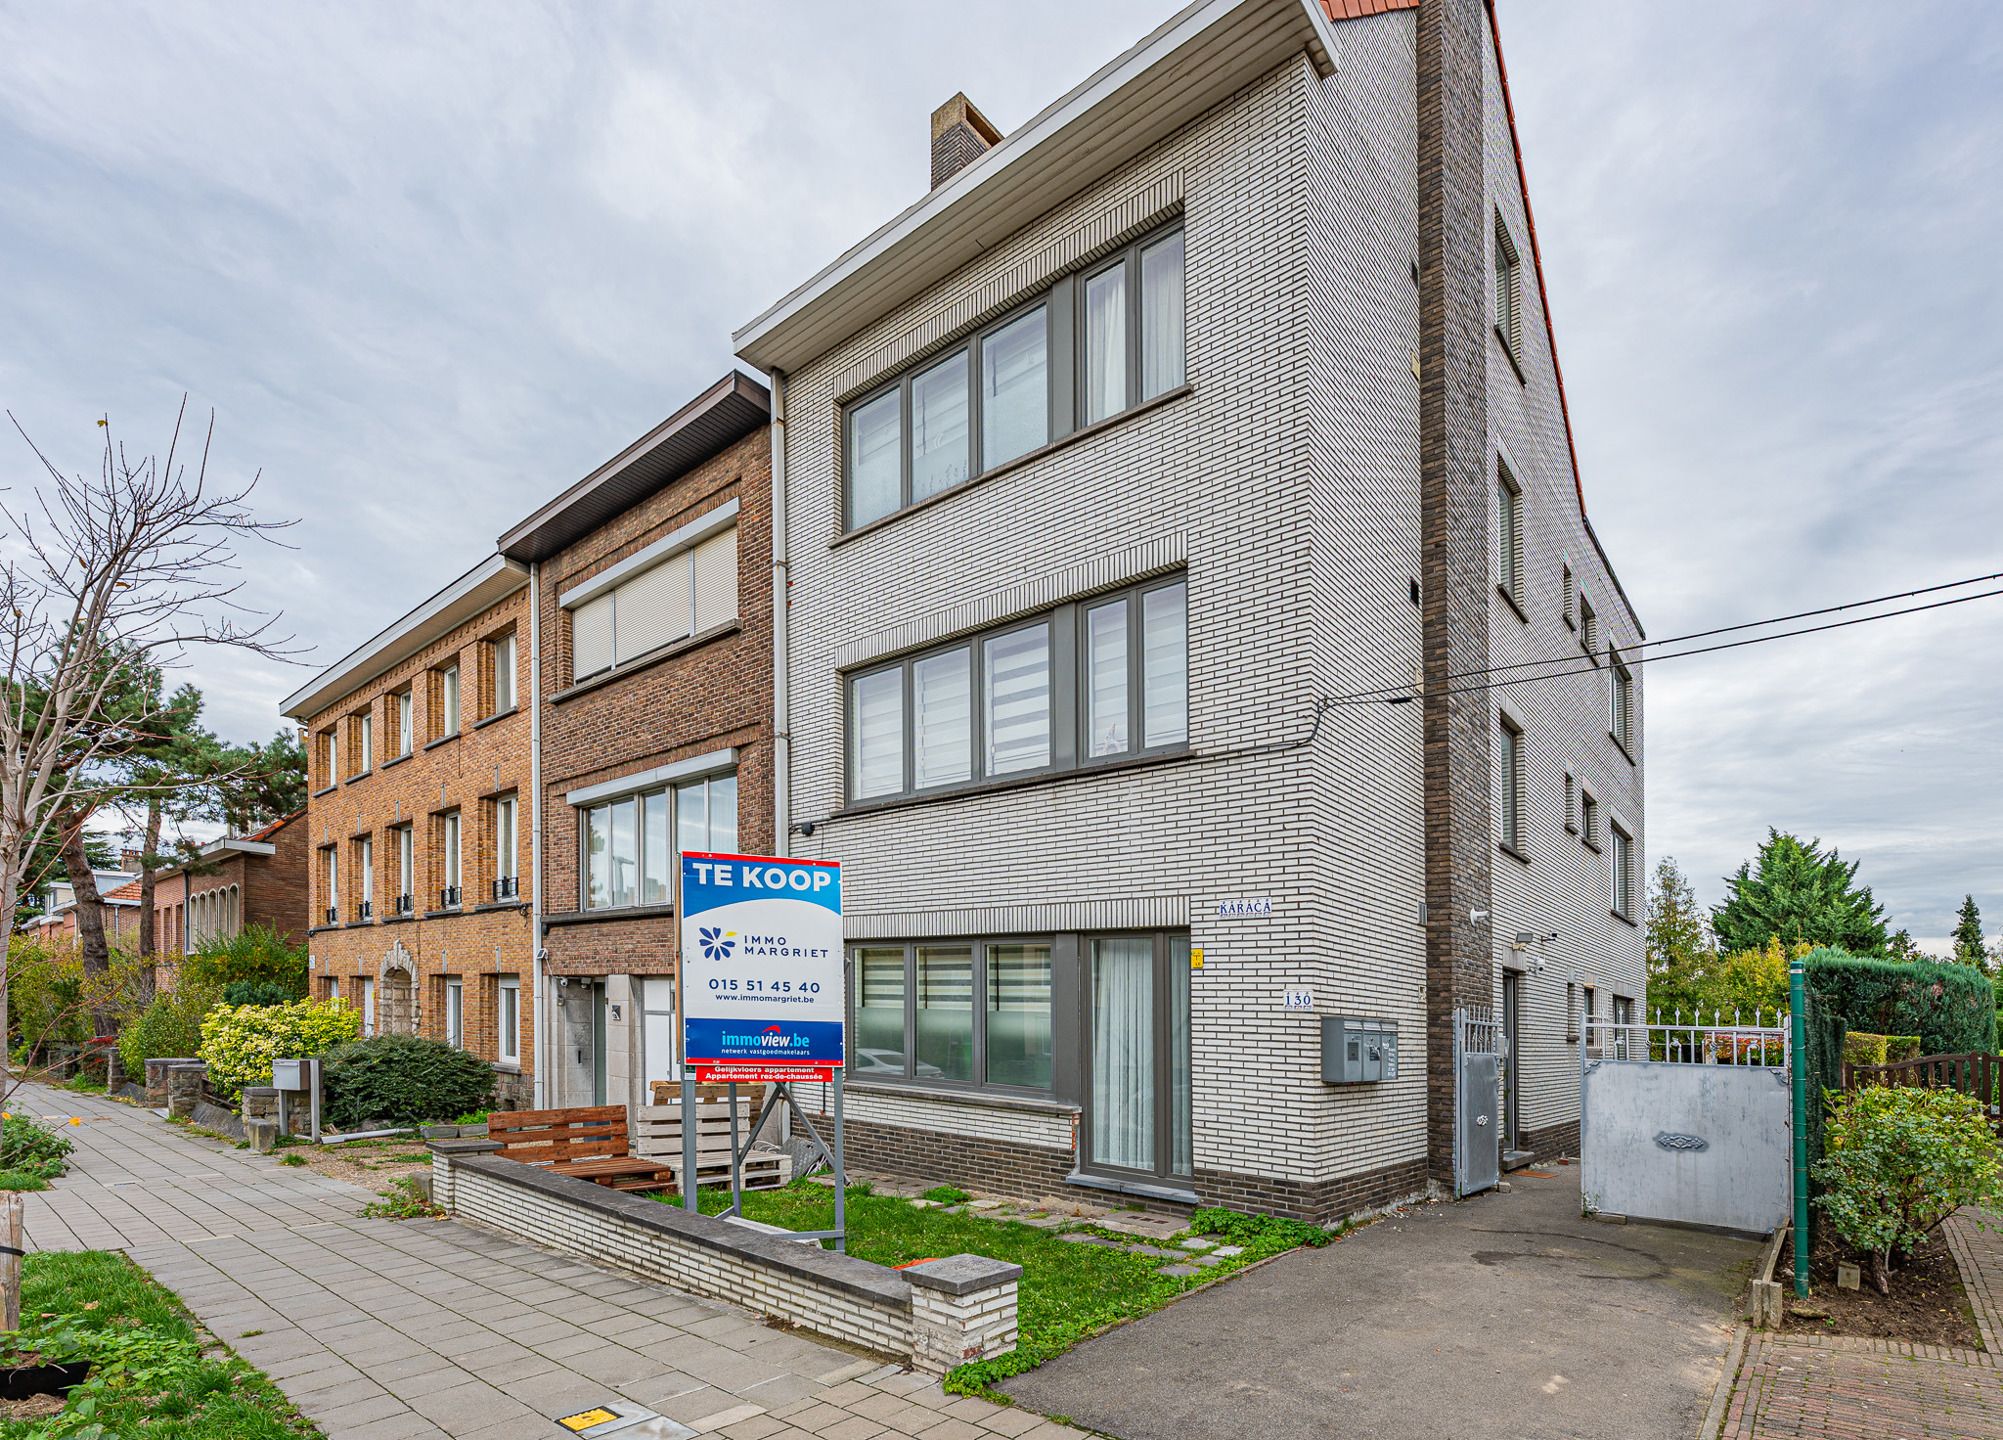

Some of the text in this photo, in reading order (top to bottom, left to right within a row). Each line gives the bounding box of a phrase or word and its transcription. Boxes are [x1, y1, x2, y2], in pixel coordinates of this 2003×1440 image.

[692, 862, 831, 892] TE KOOP
[1220, 902, 1271, 914] KARACA
[744, 935, 787, 946] IMMO
[744, 946, 829, 958] MARGRIET
[708, 978, 821, 993] 015 51 45 40
[715, 993, 815, 1004] www.immomargriet.be
[1286, 995, 1311, 1006] 130
[721, 1030, 811, 1047] immoview.be
[714, 1066, 815, 1075] Gelijkvloers appartement
[760, 1073, 824, 1081] rez-de-chaussée
